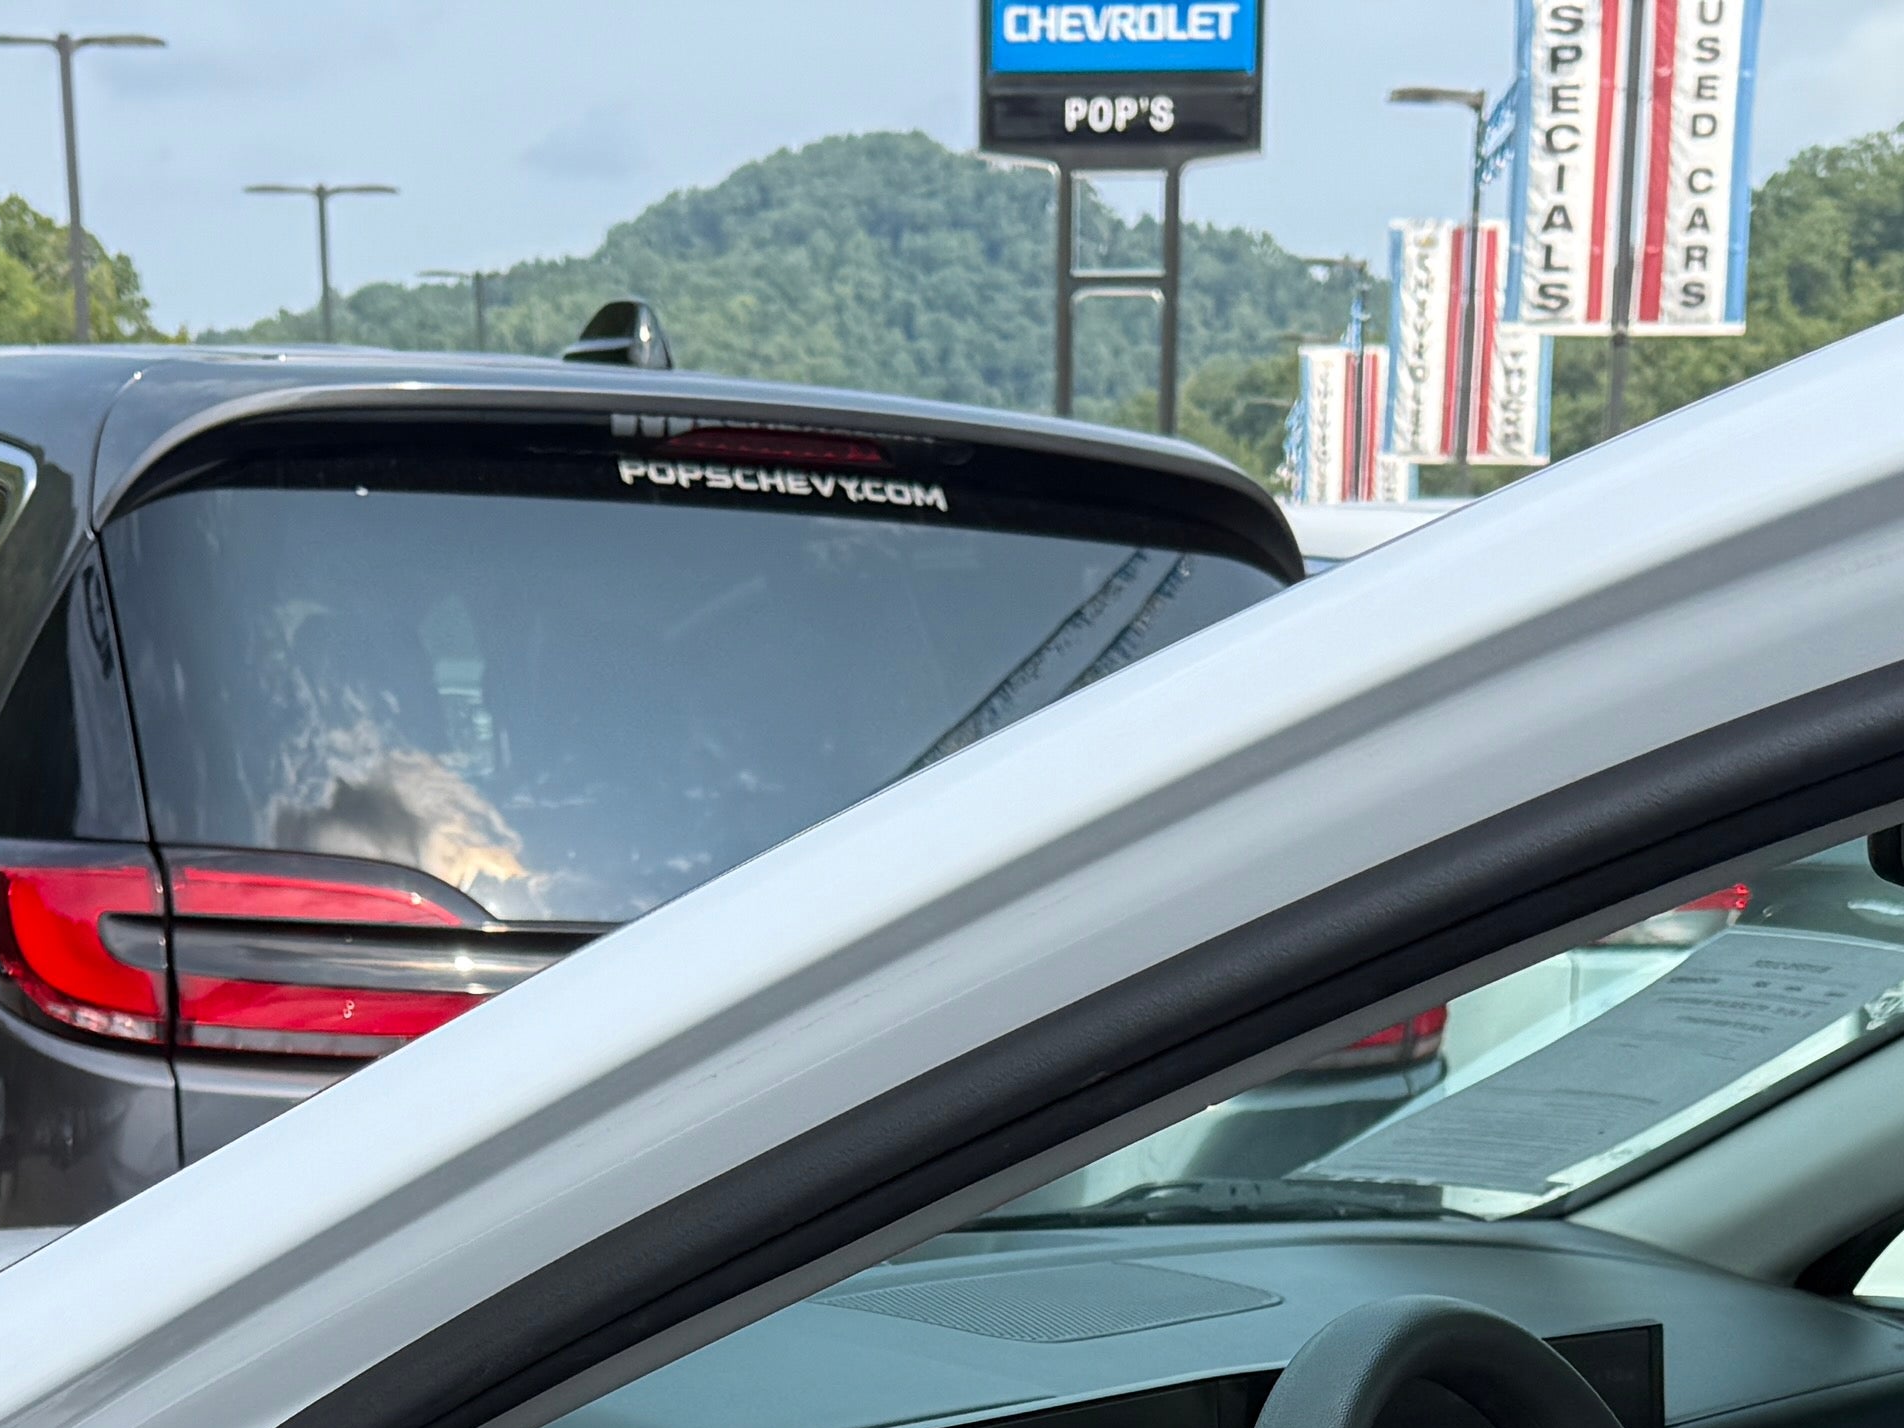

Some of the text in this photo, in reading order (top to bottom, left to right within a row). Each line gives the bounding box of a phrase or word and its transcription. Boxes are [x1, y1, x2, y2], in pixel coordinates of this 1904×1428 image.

[1003, 3, 1241, 43] CHEVROLET
[1064, 96, 1175, 133] POP'S
[1542, 4, 1585, 312] SPECIALS
[1680, 0, 1724, 309] USED CARS
[617, 459, 949, 513] POPSCHEVY.COM
